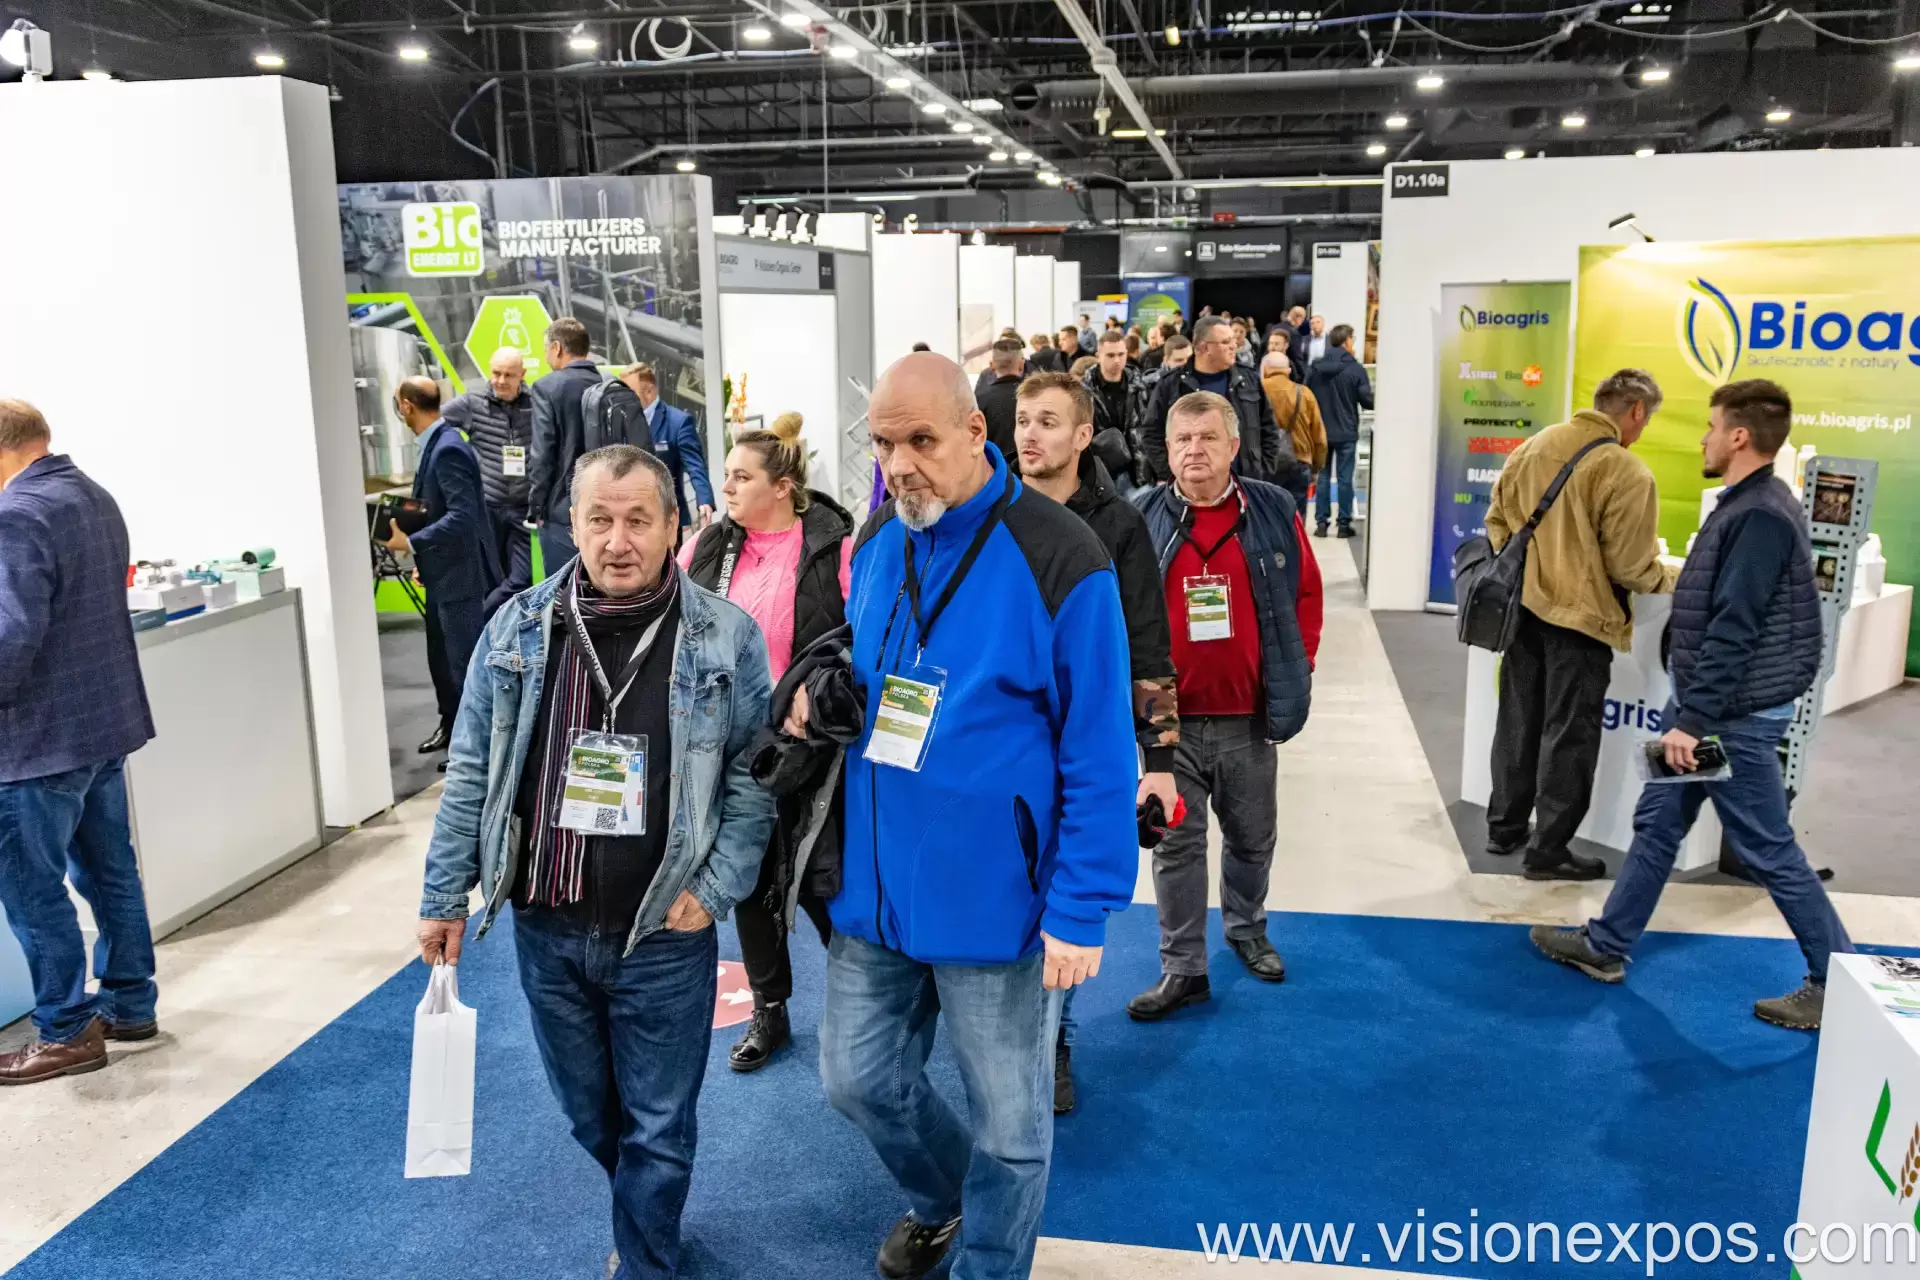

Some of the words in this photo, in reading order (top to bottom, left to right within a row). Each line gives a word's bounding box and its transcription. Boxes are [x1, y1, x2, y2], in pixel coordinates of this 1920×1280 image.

[1395, 173, 1446, 188] D1.10a
[497, 217, 646, 239] BIOFERTILIZERS
[499, 236, 662, 258] MANUFACTURER
[413, 252, 460, 267] ENERGY
[463, 251, 477, 266] LT
[1477, 310, 1550, 329] Bioagris
[1749, 301, 1920, 367] Bioa
[1851, 357, 1900, 371] natury
[1464, 418, 1532, 429] PROTECTOR
[1791, 411, 1911, 433] ww.bioagris.pl
[1454, 492, 1472, 504] NU
[1602, 698, 1661, 733] gris
